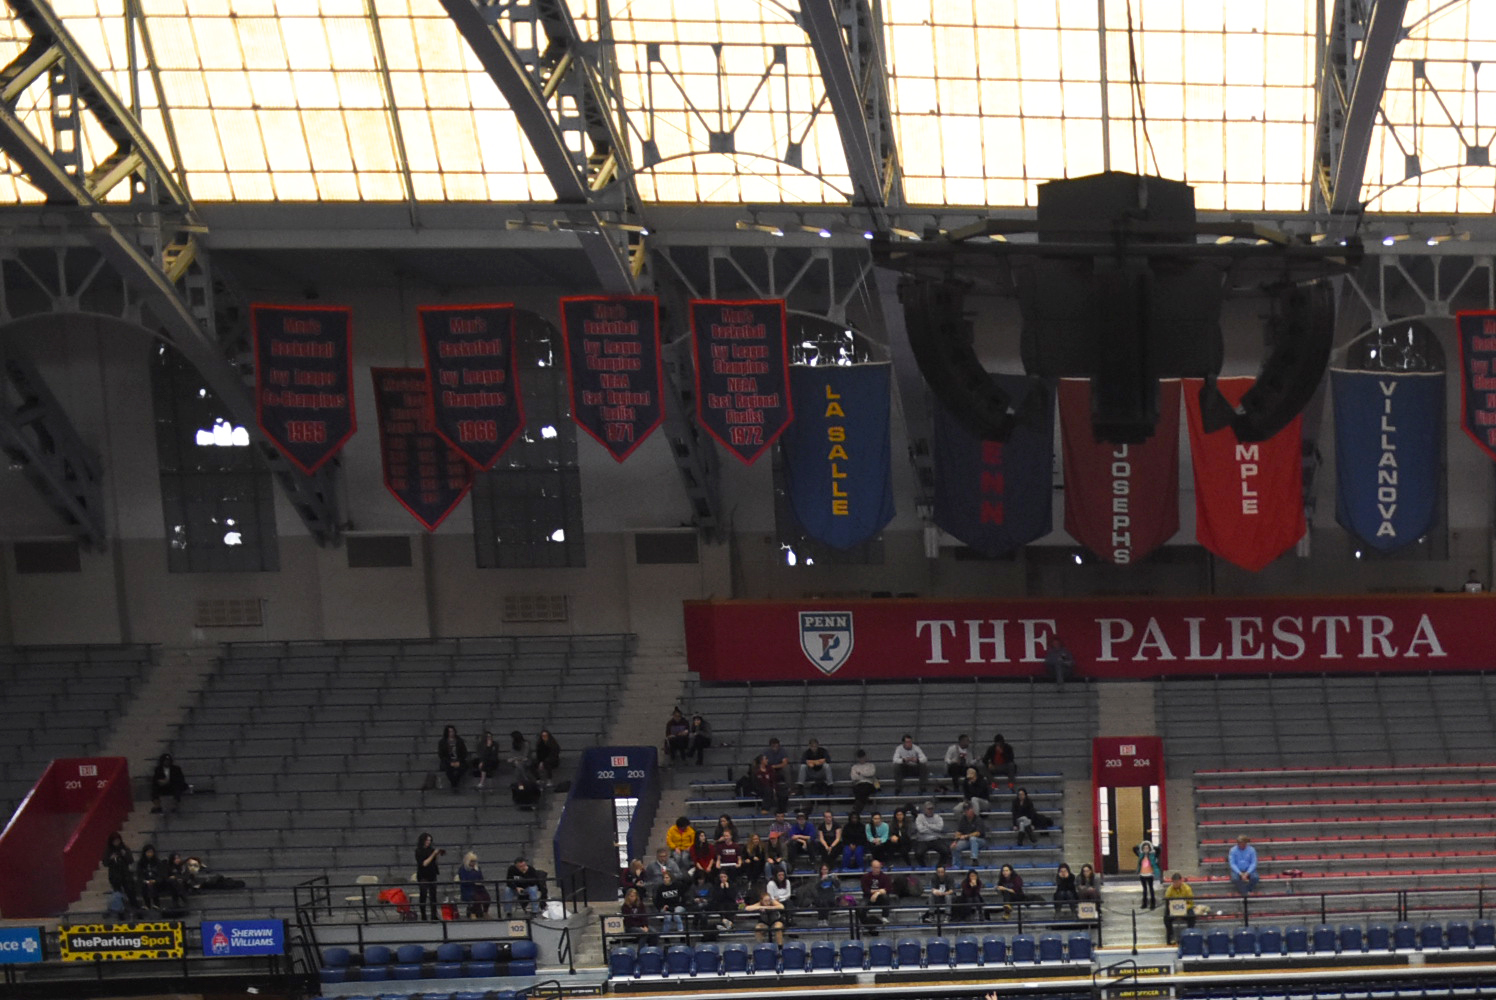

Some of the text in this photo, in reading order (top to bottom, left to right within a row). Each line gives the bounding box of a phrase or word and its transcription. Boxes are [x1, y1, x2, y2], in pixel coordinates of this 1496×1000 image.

[457, 420, 497, 443] 1966
[729, 426, 764, 445] 1972
[825, 383, 849, 516] LA SALLE
[1376, 380, 1398, 537] VILLANOVA
[980, 440, 1005, 526] ENN
[1235, 444, 1259, 515] MPLE
[1111, 443, 1131, 565] JOSEPHS
[804, 616, 847, 628] PENN
[916, 614, 1447, 664] THE PALESTRA
[614, 757, 625, 766] EXIT
[1105, 759, 1150, 768] 203 204
[597, 770, 645, 779] 202 203
[65, 780, 82, 790] 201
[72, 935, 170, 948] theParkingSpot
[231, 928, 273, 937] SHERWIN
